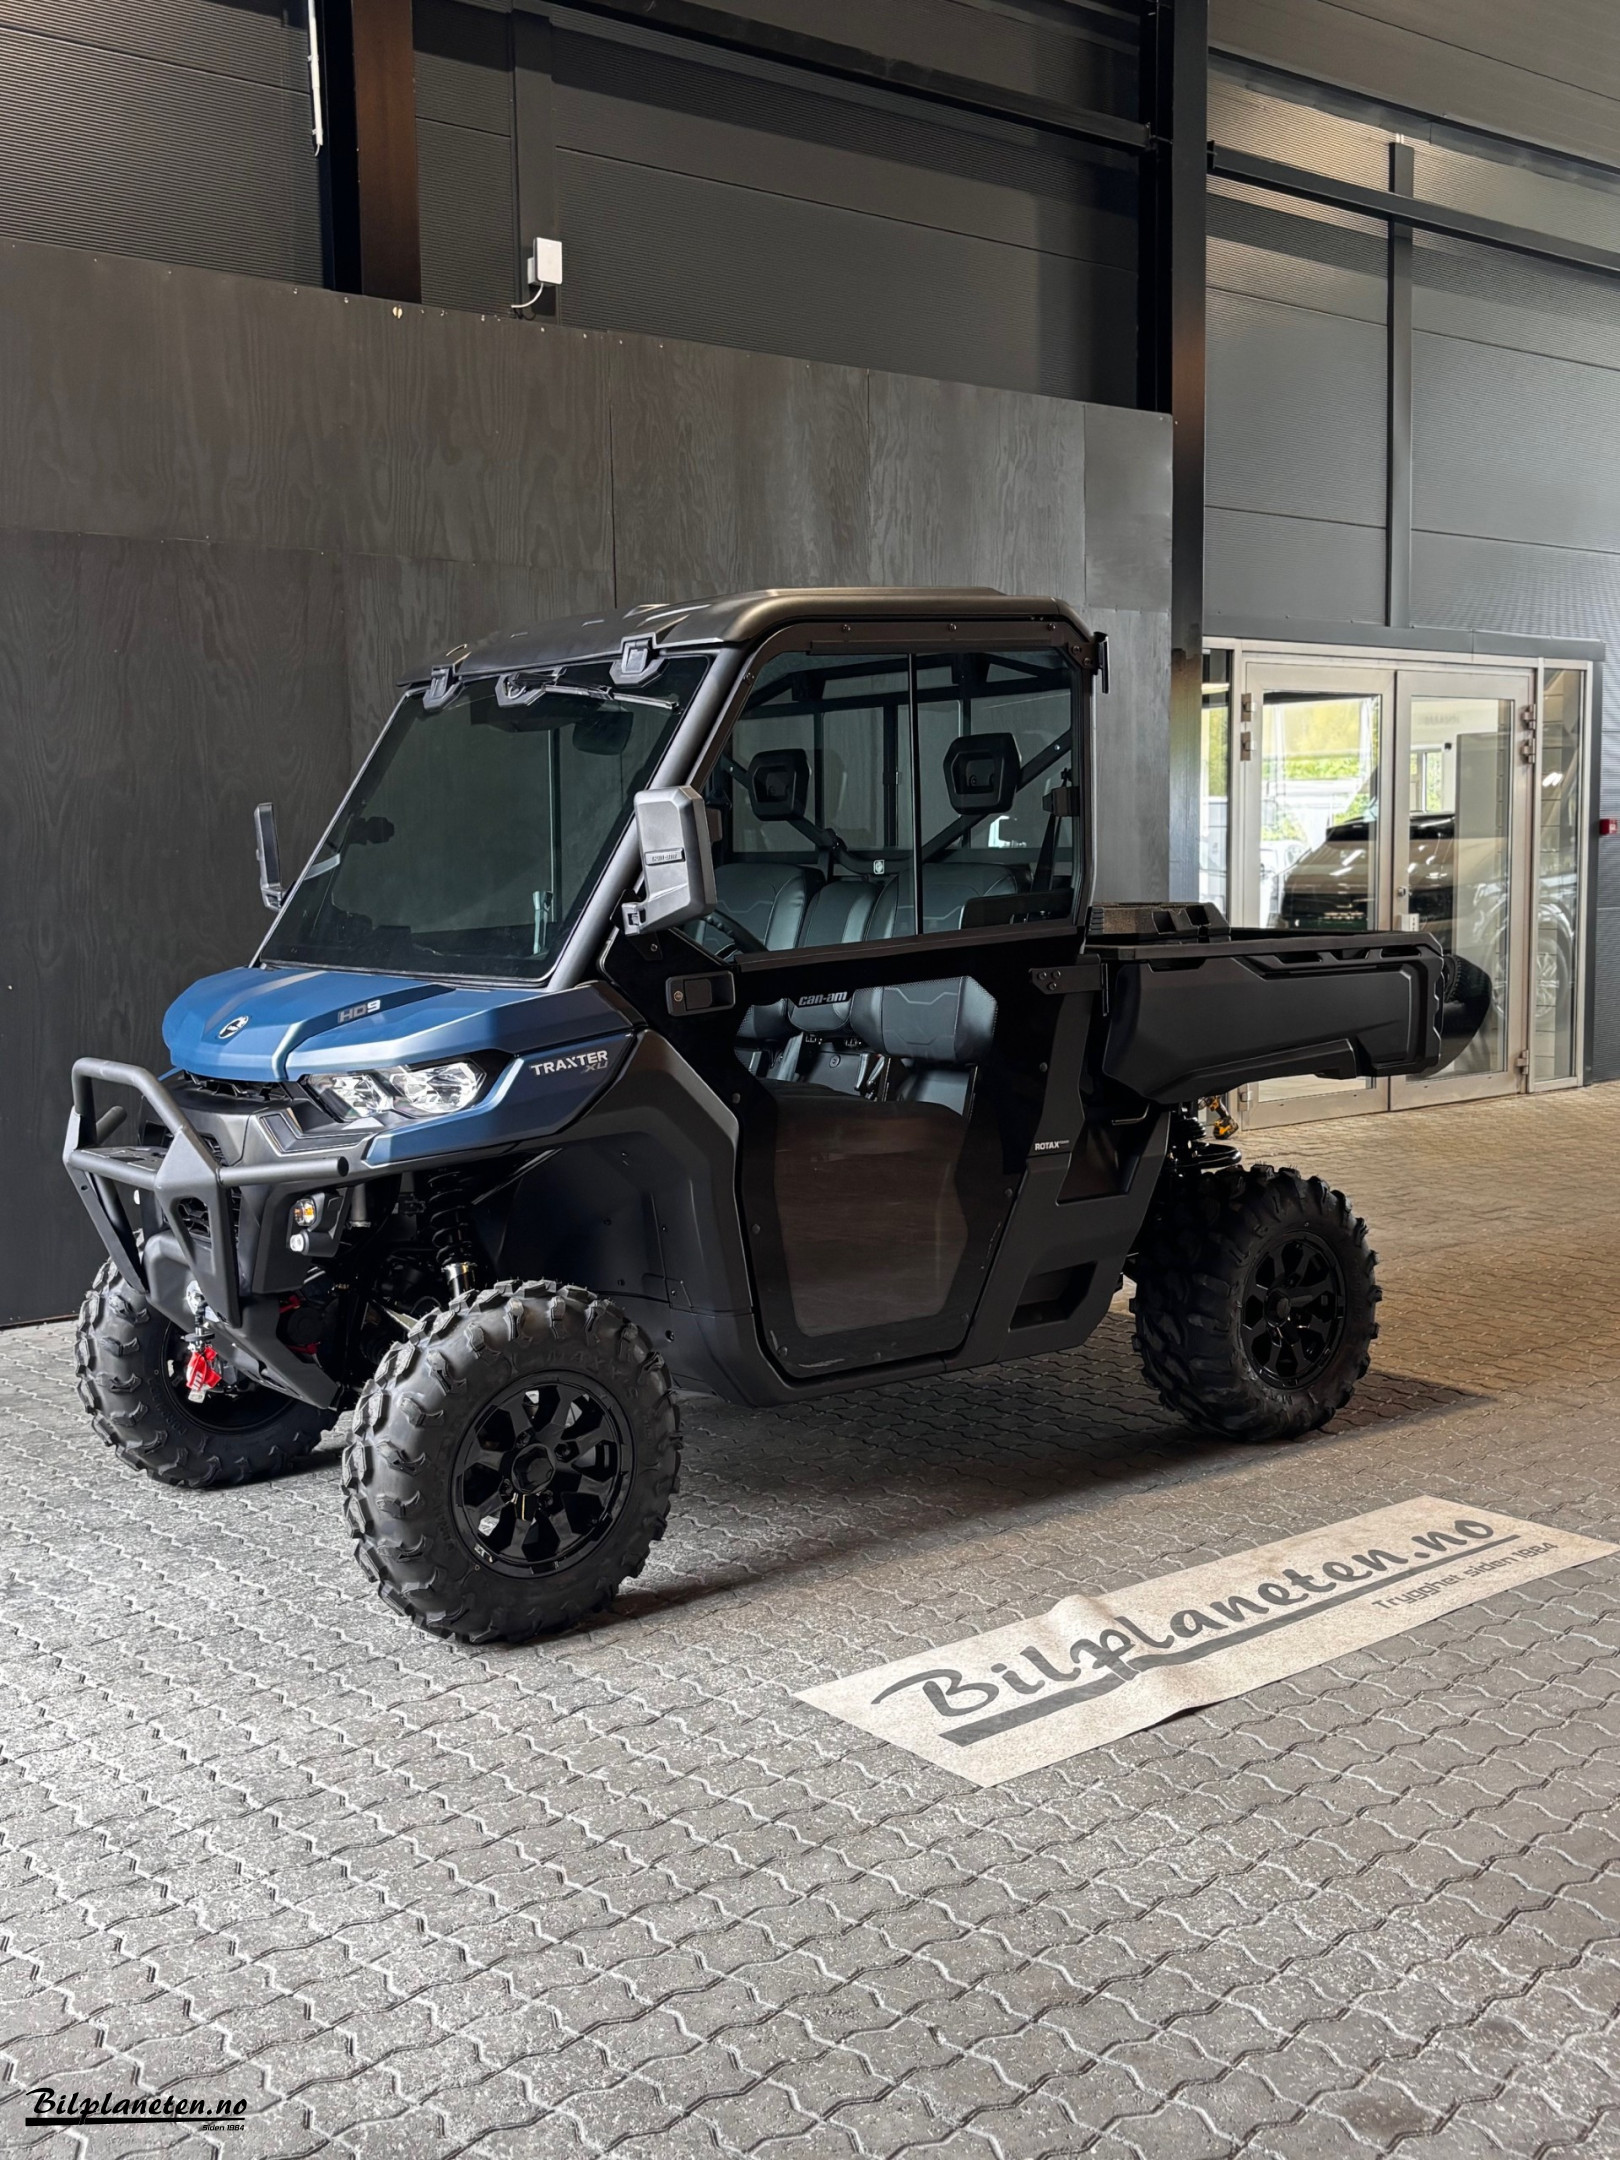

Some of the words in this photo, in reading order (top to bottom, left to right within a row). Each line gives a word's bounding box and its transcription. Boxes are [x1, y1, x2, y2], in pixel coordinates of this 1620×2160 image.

[798, 991, 848, 1006] can-am
[530, 1050, 608, 1076] TRAXTER
[1034, 1141, 1060, 1151] ROTAX
[1371, 1573, 1465, 1610] Trygghet
[1463, 1556, 1517, 1577] siden
[1512, 1541, 1559, 1559] 1984
[871, 1519, 1494, 1717] Bilplaneten.no
